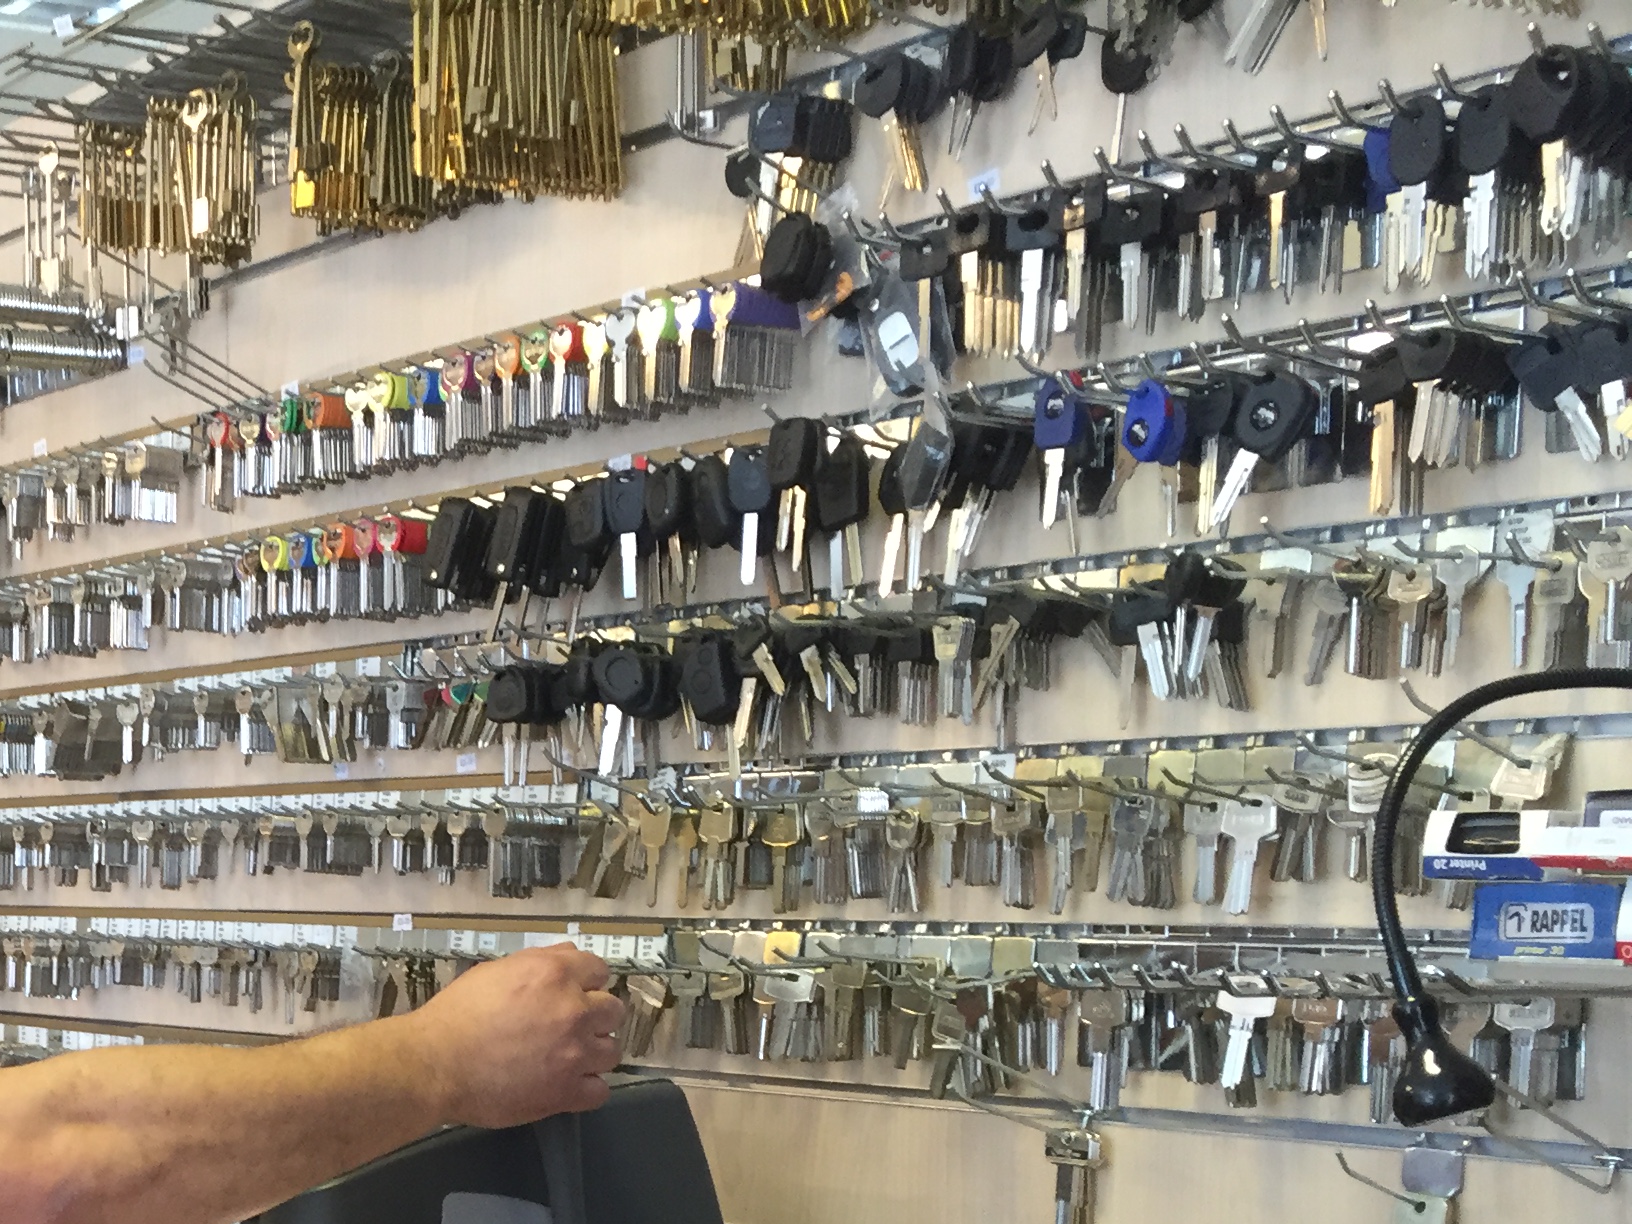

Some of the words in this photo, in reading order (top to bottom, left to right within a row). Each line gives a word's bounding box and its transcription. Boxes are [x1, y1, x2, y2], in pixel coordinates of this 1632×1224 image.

[1433, 858, 1447, 870] 20
[1449, 859, 1487, 871] Printer
[1529, 907, 1588, 934] RAPPEL
